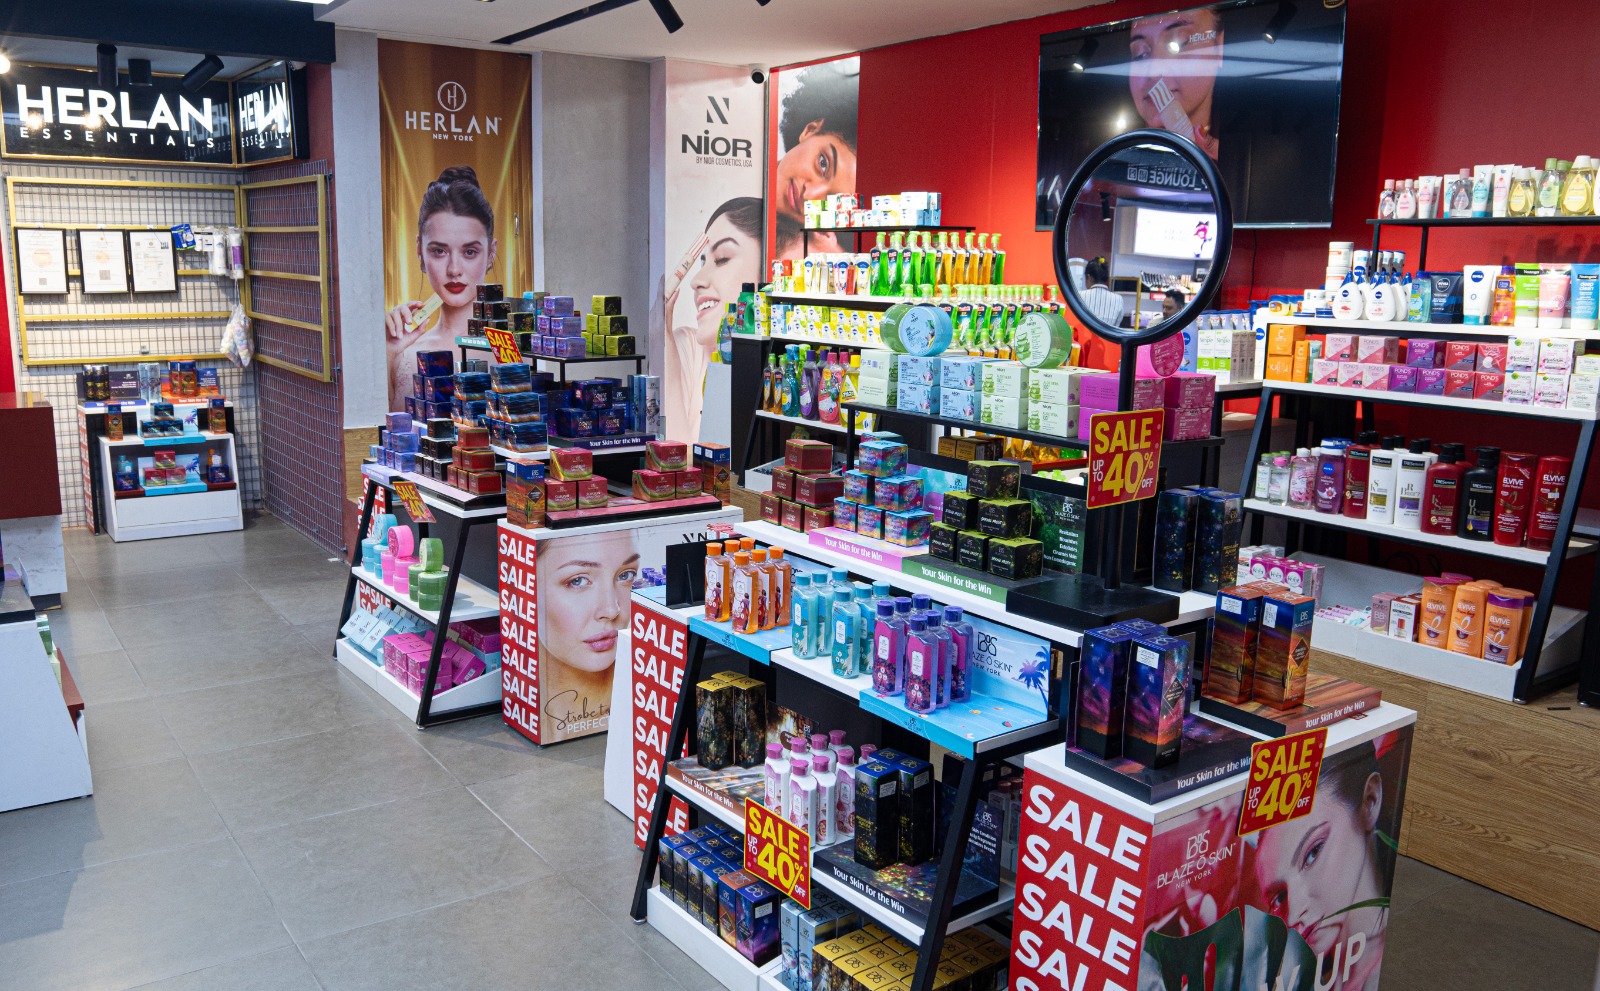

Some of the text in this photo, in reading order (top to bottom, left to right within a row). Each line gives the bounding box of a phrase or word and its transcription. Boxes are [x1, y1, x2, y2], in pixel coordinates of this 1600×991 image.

[1190, 31, 1216, 44] HERLAN
[16, 83, 213, 134] HERLAN
[20, 126, 215, 148] ESSENTIALS
[405, 110, 499, 136] HERLAN
[454, 134, 474, 142] YORK
[696, 156, 702, 164] BY
[743, 159, 753, 168] USA
[487, 331, 514, 350] SALE
[1094, 418, 1154, 454] SALE
[1092, 460, 1104, 471] UP
[1092, 472, 1104, 482] TO
[1543, 474, 1565, 483] ELVIVE
[396, 484, 419, 500] SALE
[1142, 478, 1153, 488] OFF
[1503, 477, 1524, 486] ELVIVE
[499, 537, 536, 566] SALE
[825, 537, 882, 562] Your Skin for the Win
[500, 563, 536, 596] SALE
[922, 566, 992, 595] Your Skin for the Win
[500, 590, 536, 622] SALE
[1426, 603, 1447, 611] ELVIVE
[1458, 603, 1476, 611] ELVIVE
[501, 617, 536, 652] SALE
[1490, 616, 1510, 626] ELVIVE
[632, 612, 685, 660] SALE
[502, 644, 536, 674] SALE
[634, 648, 685, 694] SALE
[986, 666, 1001, 677] YORK
[502, 670, 537, 708] SALE
[504, 697, 538, 736] SALE
[544, 690, 596, 730] Strobe
[634, 682, 677, 726] SAL
[1306, 701, 1365, 729] Your Skin for the Win
[1254, 737, 1316, 783] SALE
[1176, 776, 1195, 790] Your
[1196, 770, 1213, 786] Skin
[1214, 764, 1226, 778] for
[1226, 760, 1240, 774] the
[682, 773, 734, 809] Your Skin for the Win
[1247, 796, 1259, 809] TO
[1249, 786, 1261, 799] UP
[1297, 796, 1310, 809] OFF
[748, 834, 758, 847] UP
[749, 806, 800, 860] SALE
[1026, 785, 1148, 872] SALE
[748, 843, 758, 856] TO
[1022, 834, 1142, 924] SALE
[1157, 860, 1195, 889] BLAZE
[1176, 869, 1212, 890] NEW YORK
[795, 883, 806, 898] OFF
[834, 866, 905, 914] Your Skin for the Win
[1018, 883, 1136, 974] SALE
[1314, 932, 1366, 991] UP
